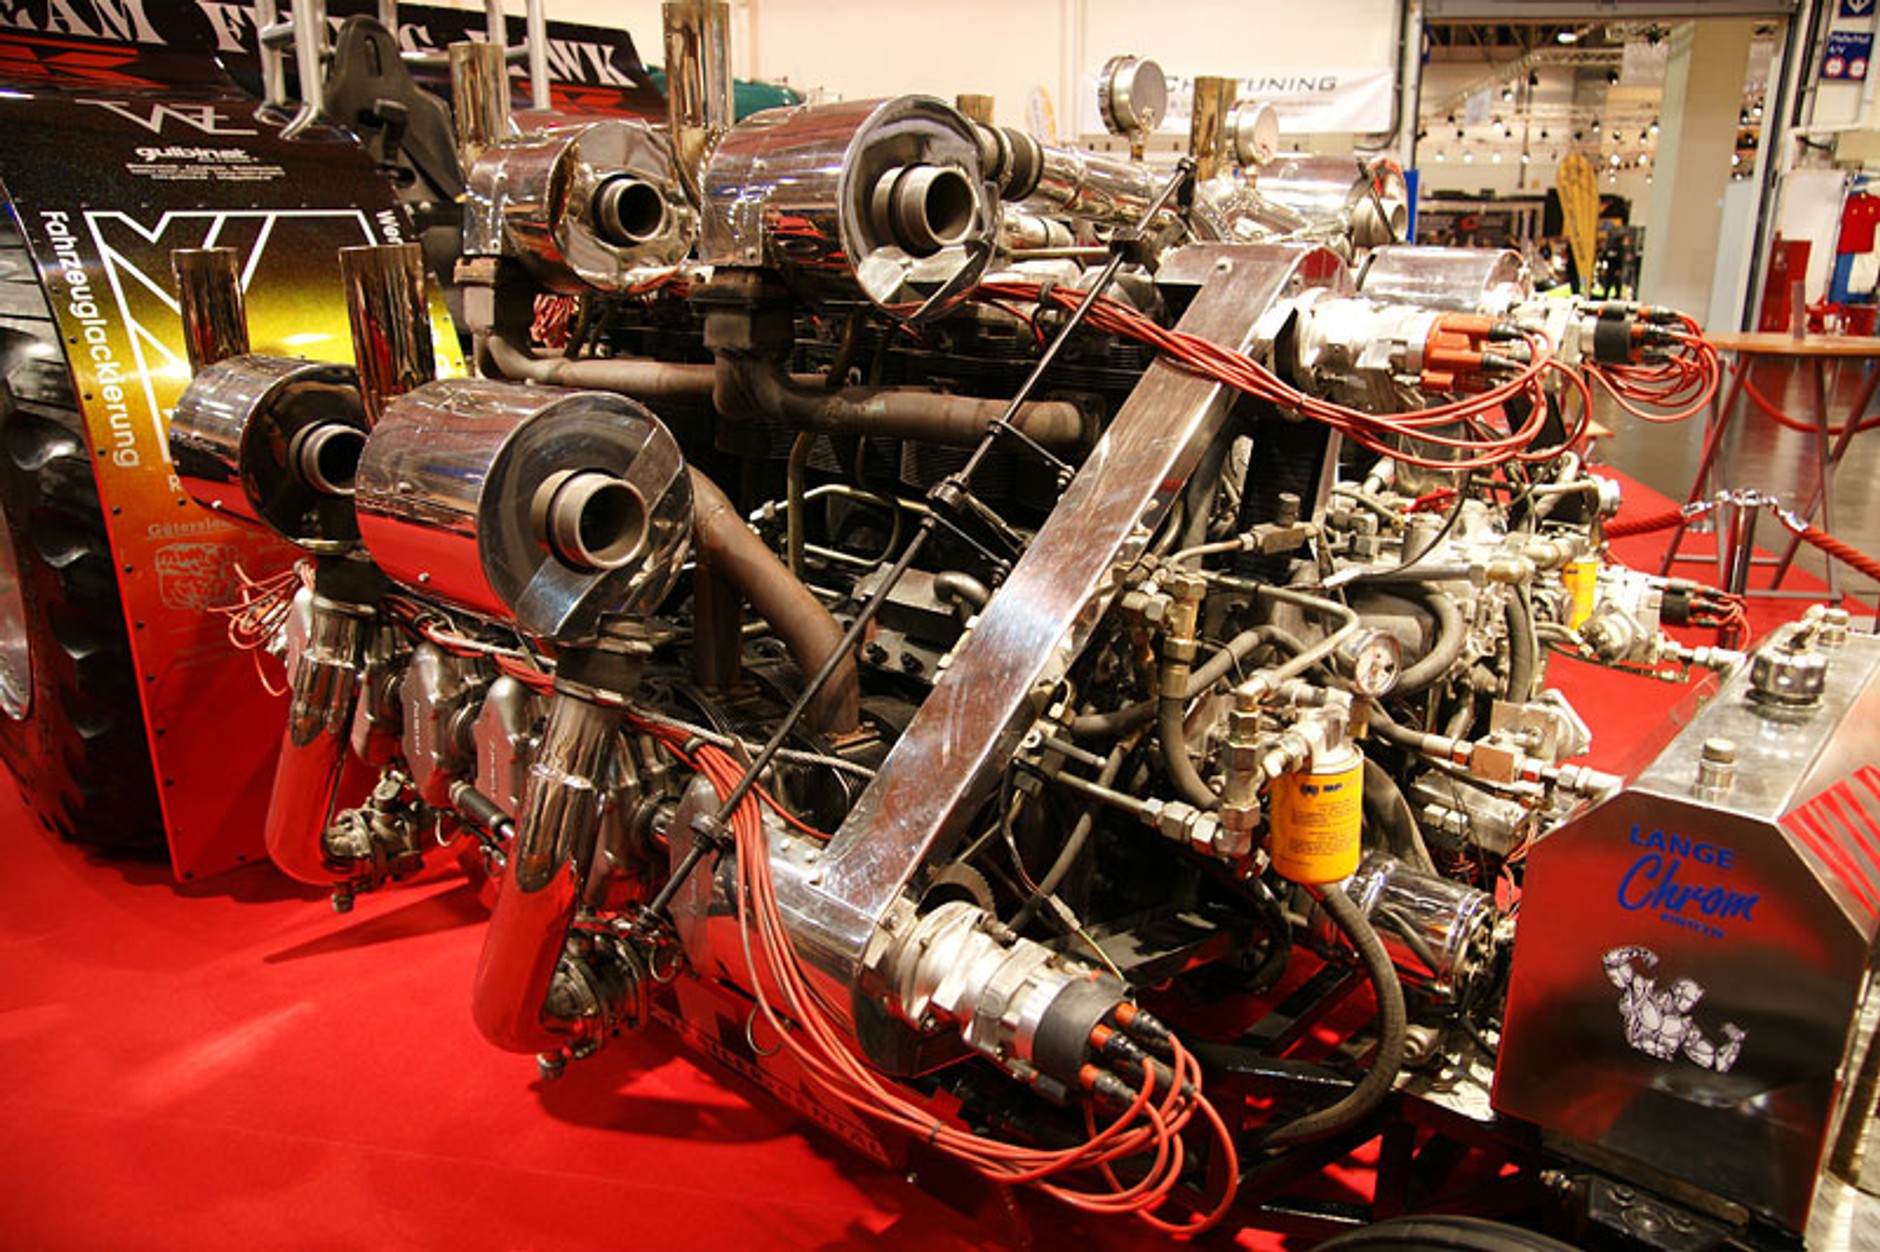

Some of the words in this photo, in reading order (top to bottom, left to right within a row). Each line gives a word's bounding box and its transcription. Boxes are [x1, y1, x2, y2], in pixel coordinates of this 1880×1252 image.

[40, 210, 140, 468] Fahrzeuglackierung
[1630, 824, 1734, 869] LANGE
[1618, 853, 1760, 921] Chrom
